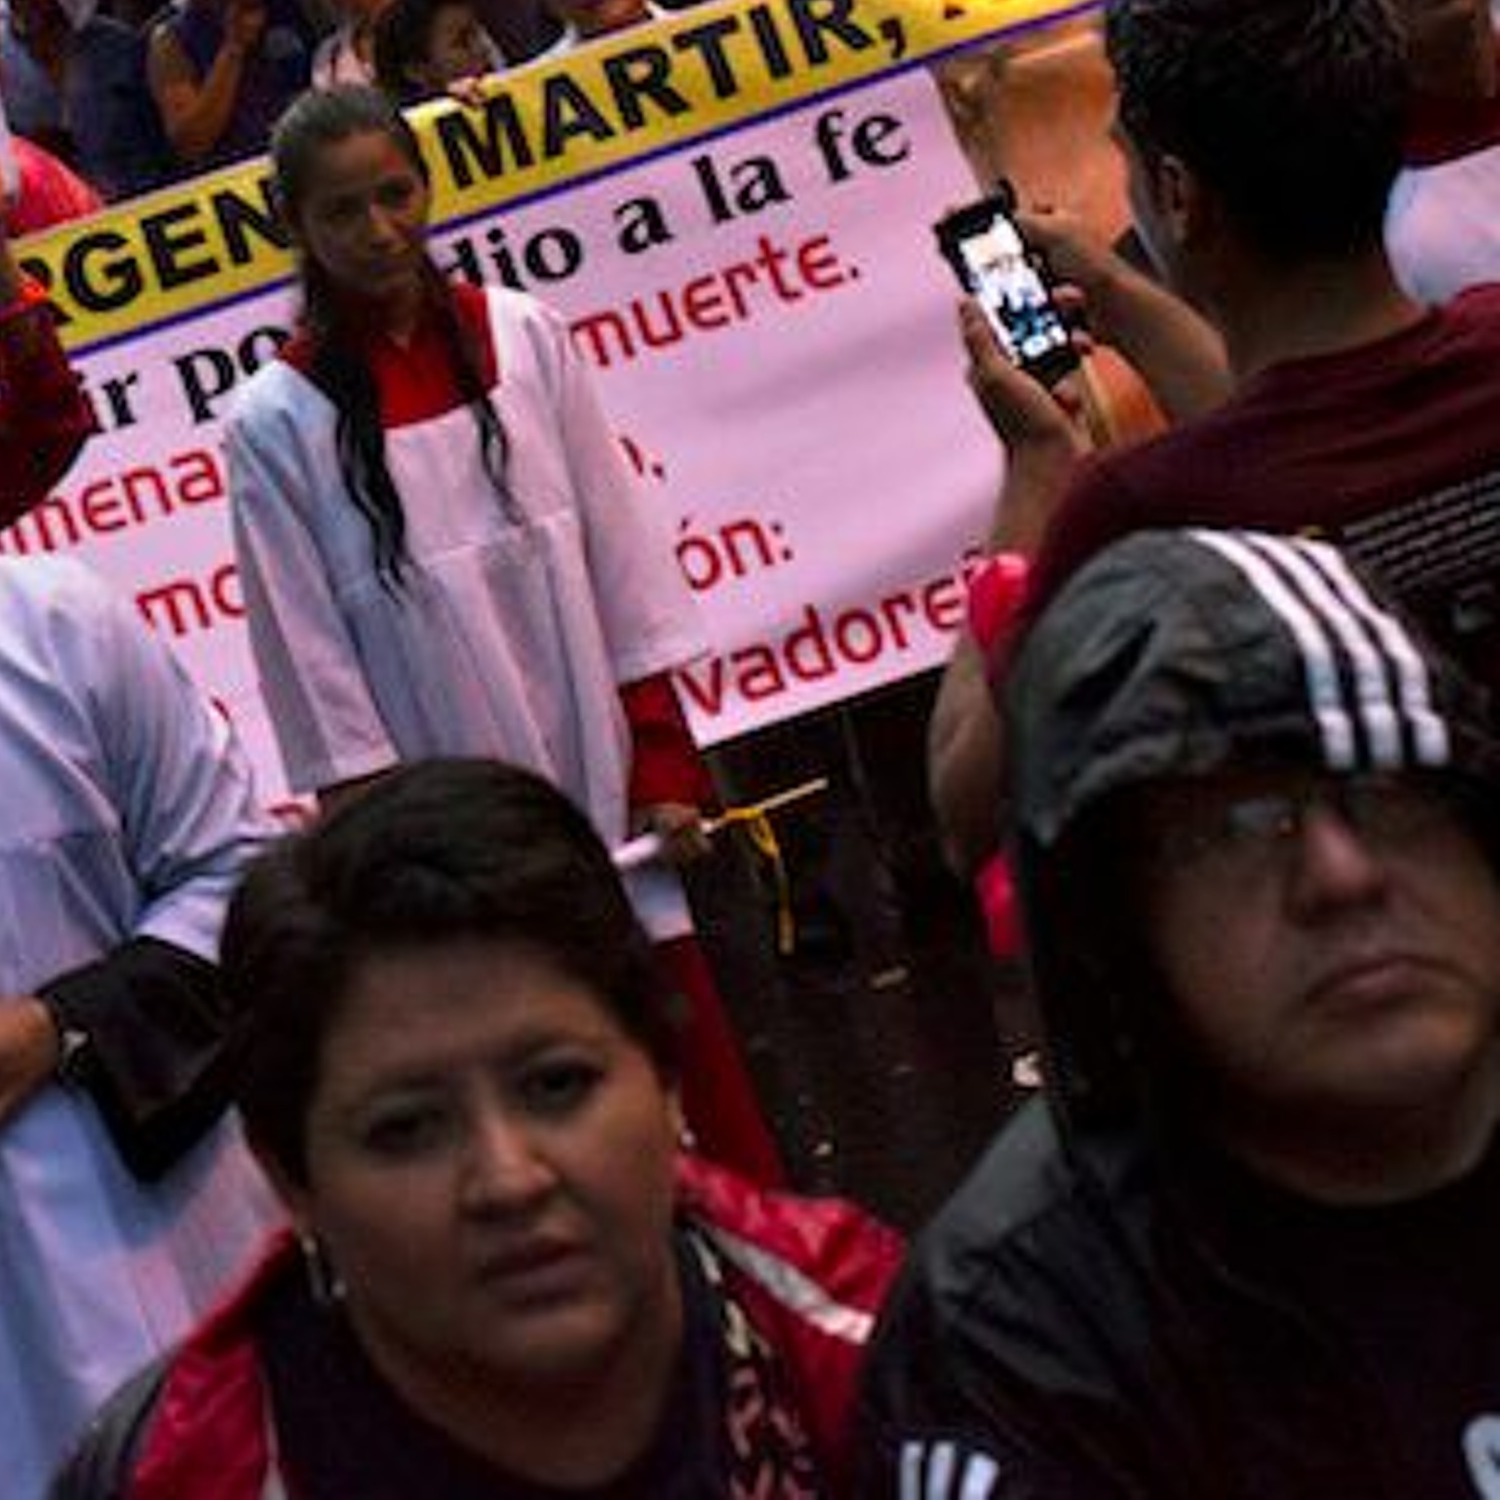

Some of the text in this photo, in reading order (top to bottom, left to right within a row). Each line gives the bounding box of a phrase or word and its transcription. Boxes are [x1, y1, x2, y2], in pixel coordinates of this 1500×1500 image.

[612, 195, 674, 255] a
[692, 153, 793, 227] la
[815, 109, 912, 184] fe
[568, 233, 861, 368] muerte.
